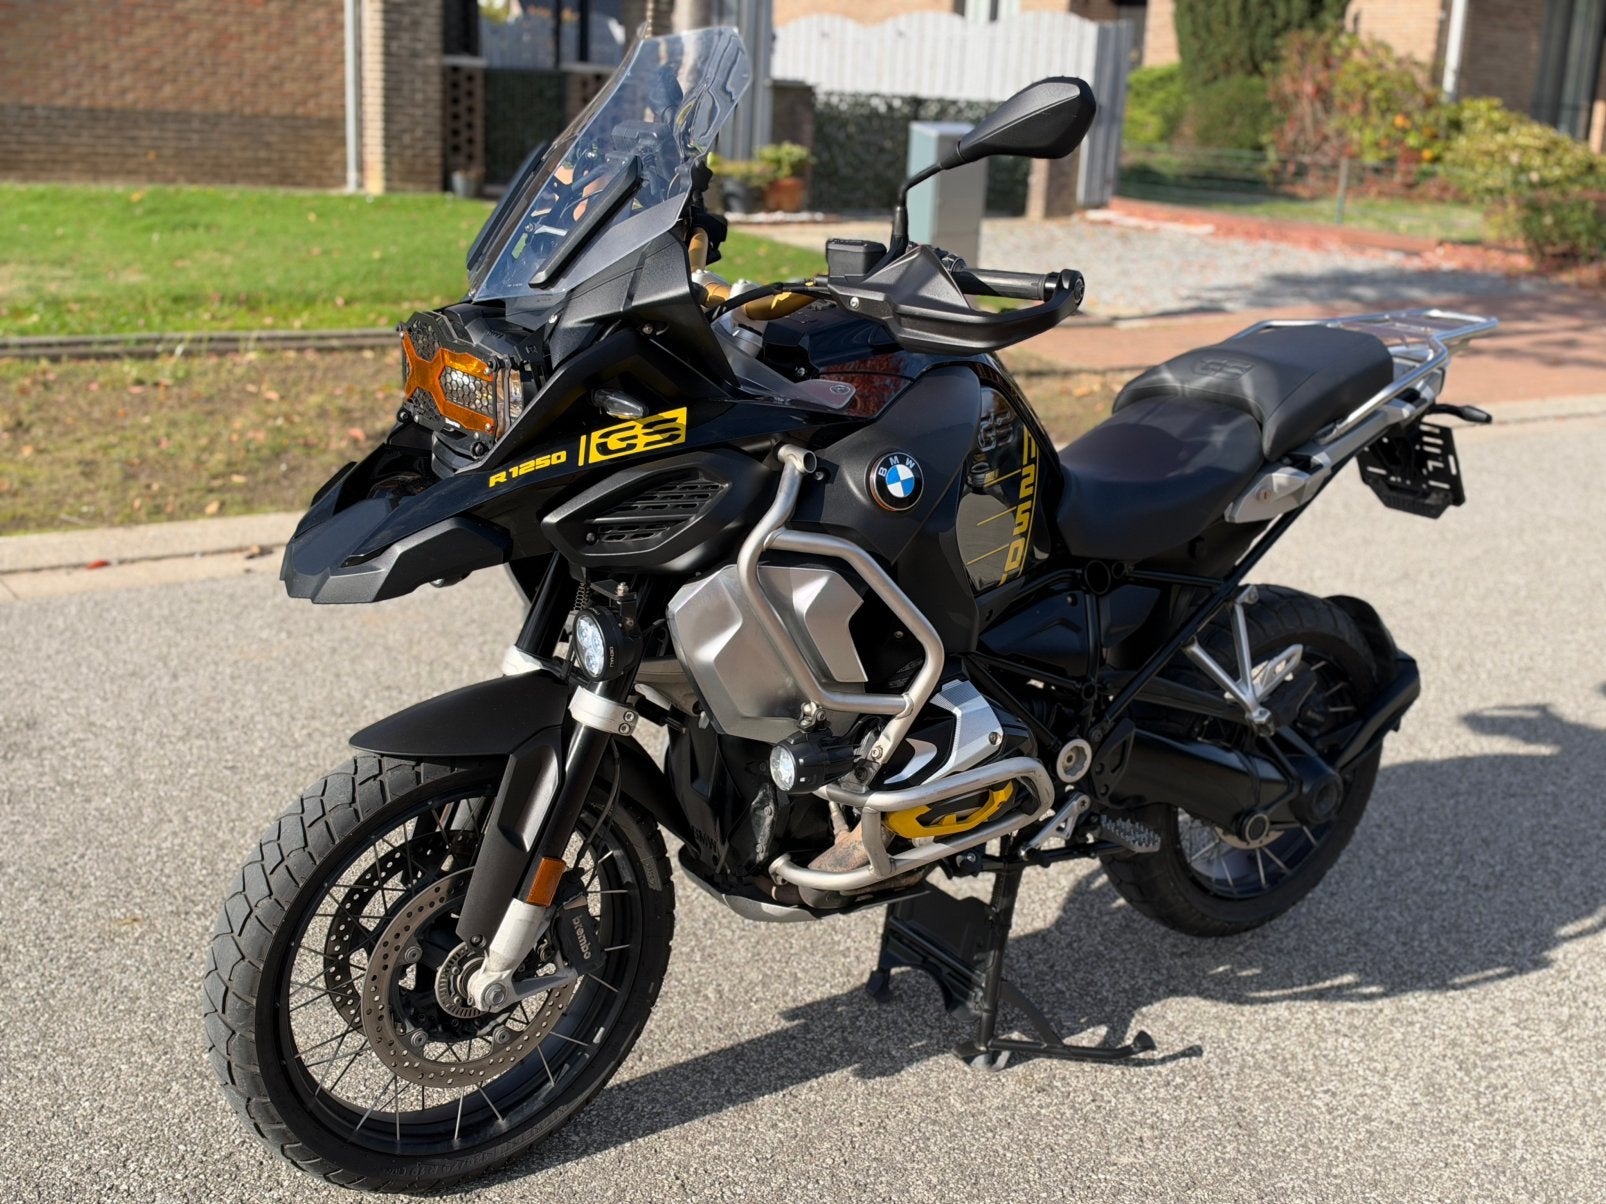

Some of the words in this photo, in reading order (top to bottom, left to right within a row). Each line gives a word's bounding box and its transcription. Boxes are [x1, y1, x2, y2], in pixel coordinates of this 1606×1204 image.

[489, 470, 507, 488] R
[508, 450, 567, 479] 1250
[594, 414, 684, 458] GS
[877, 456, 916, 478] BMW
[572, 914, 592, 960] brembo
